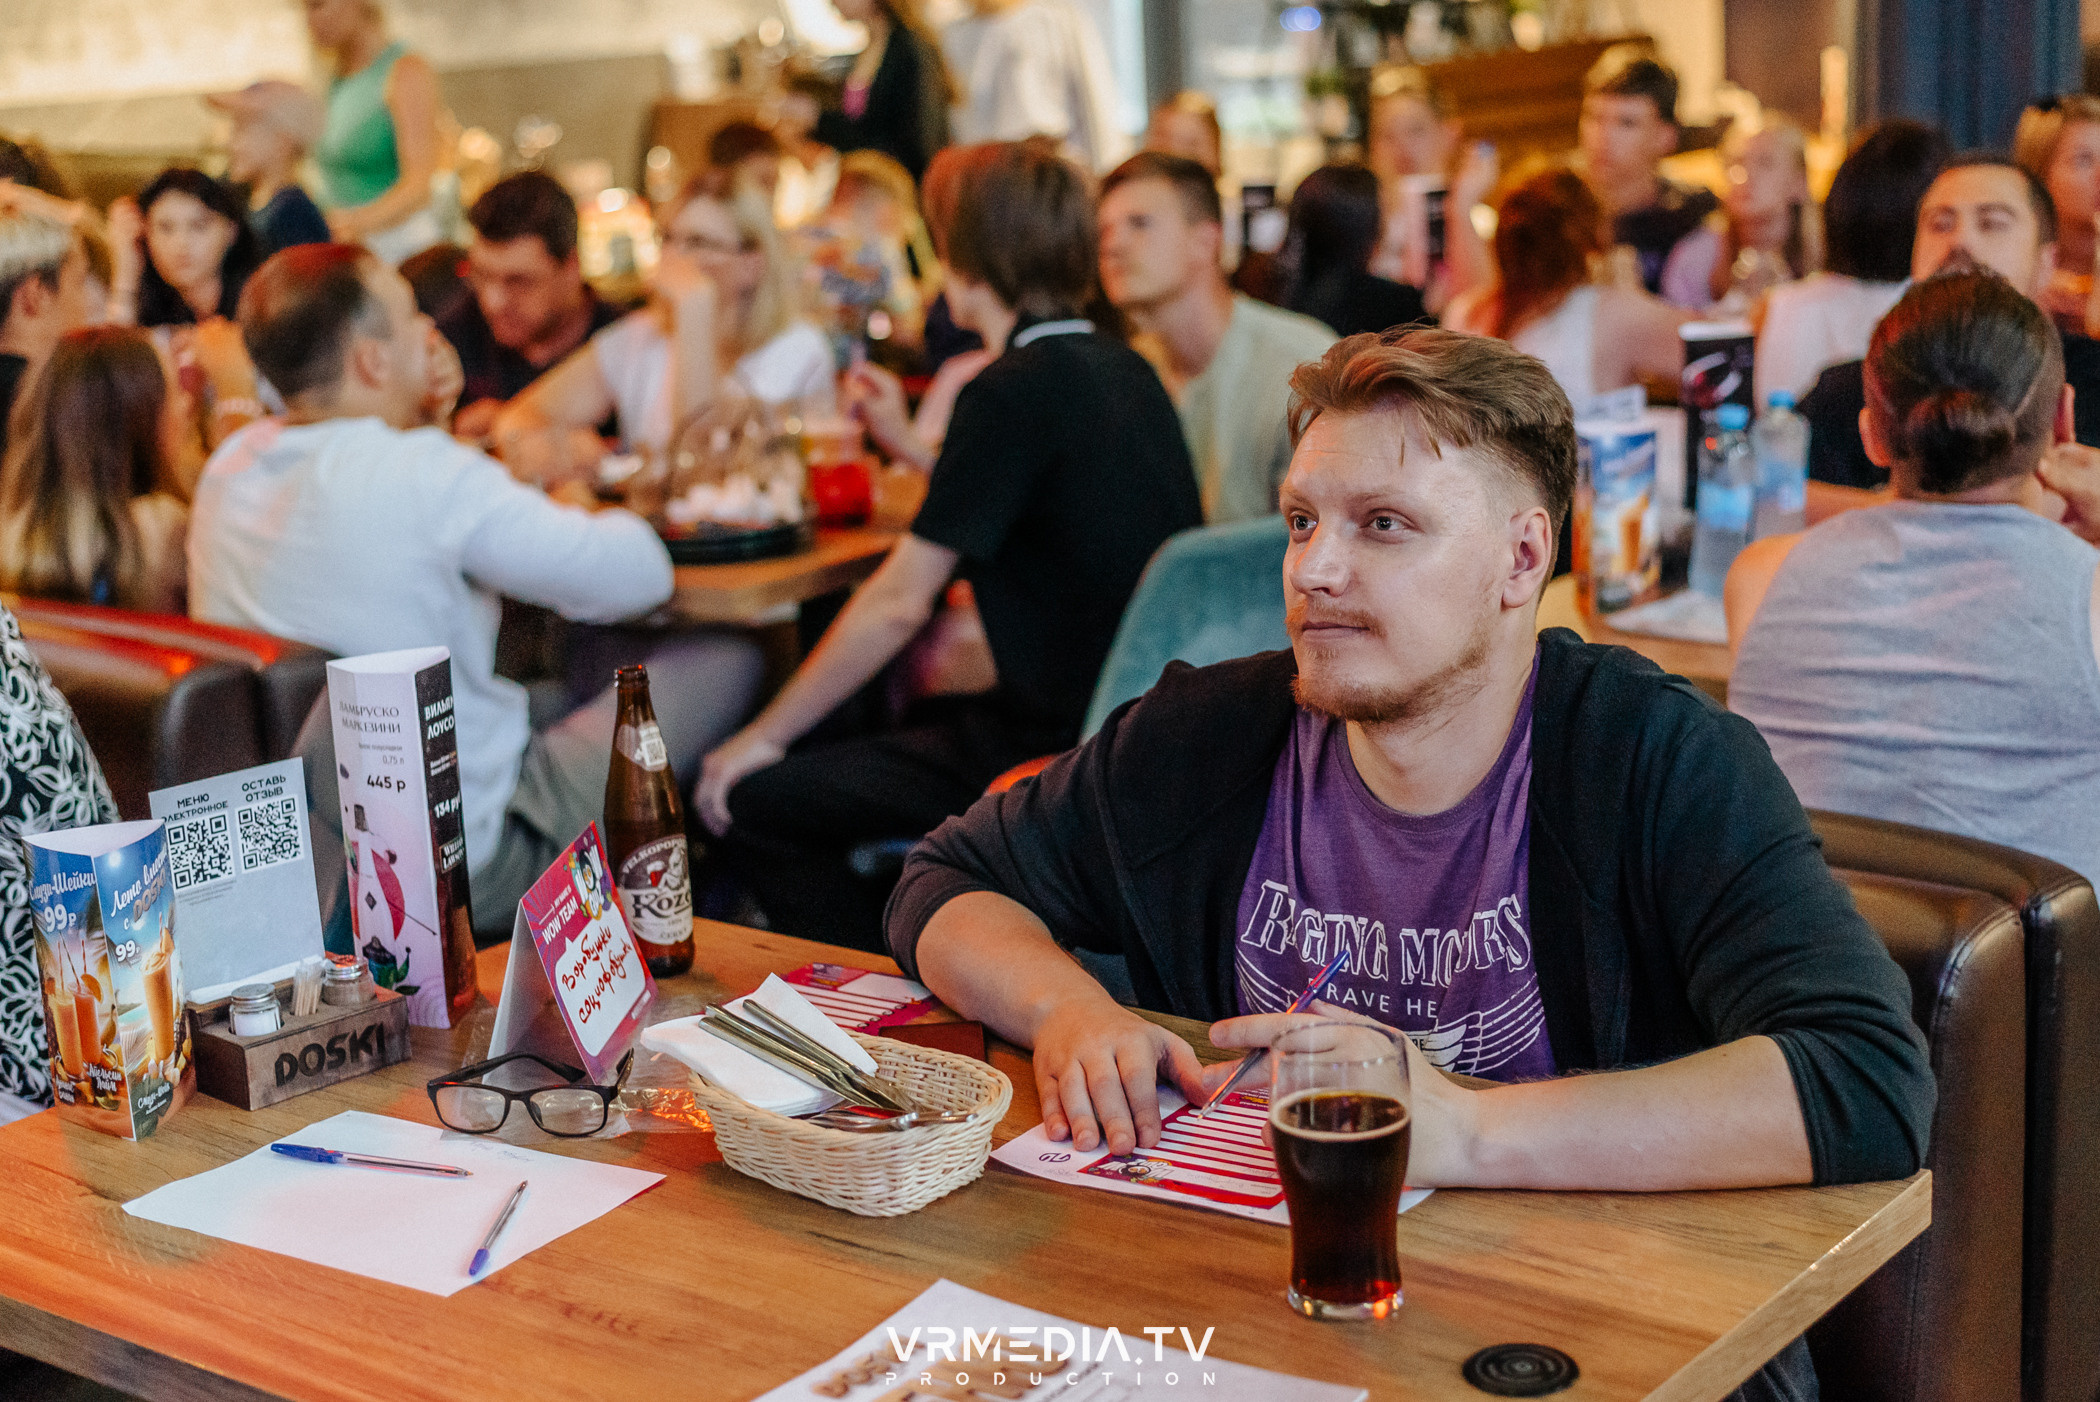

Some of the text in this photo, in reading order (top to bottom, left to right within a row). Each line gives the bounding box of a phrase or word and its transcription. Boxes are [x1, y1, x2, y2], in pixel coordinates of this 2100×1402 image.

[241, 774, 287, 792] ОСТАВЬ
[367, 775, 392, 789] 445
[177, 793, 210, 809] МЕНЮ
[245, 786, 284, 802] ОТЗЫВ
[111, 879, 142, 918] Лето
[541, 895, 579, 945] WOW TEAM
[274, 1022, 386, 1088] DOSKI
